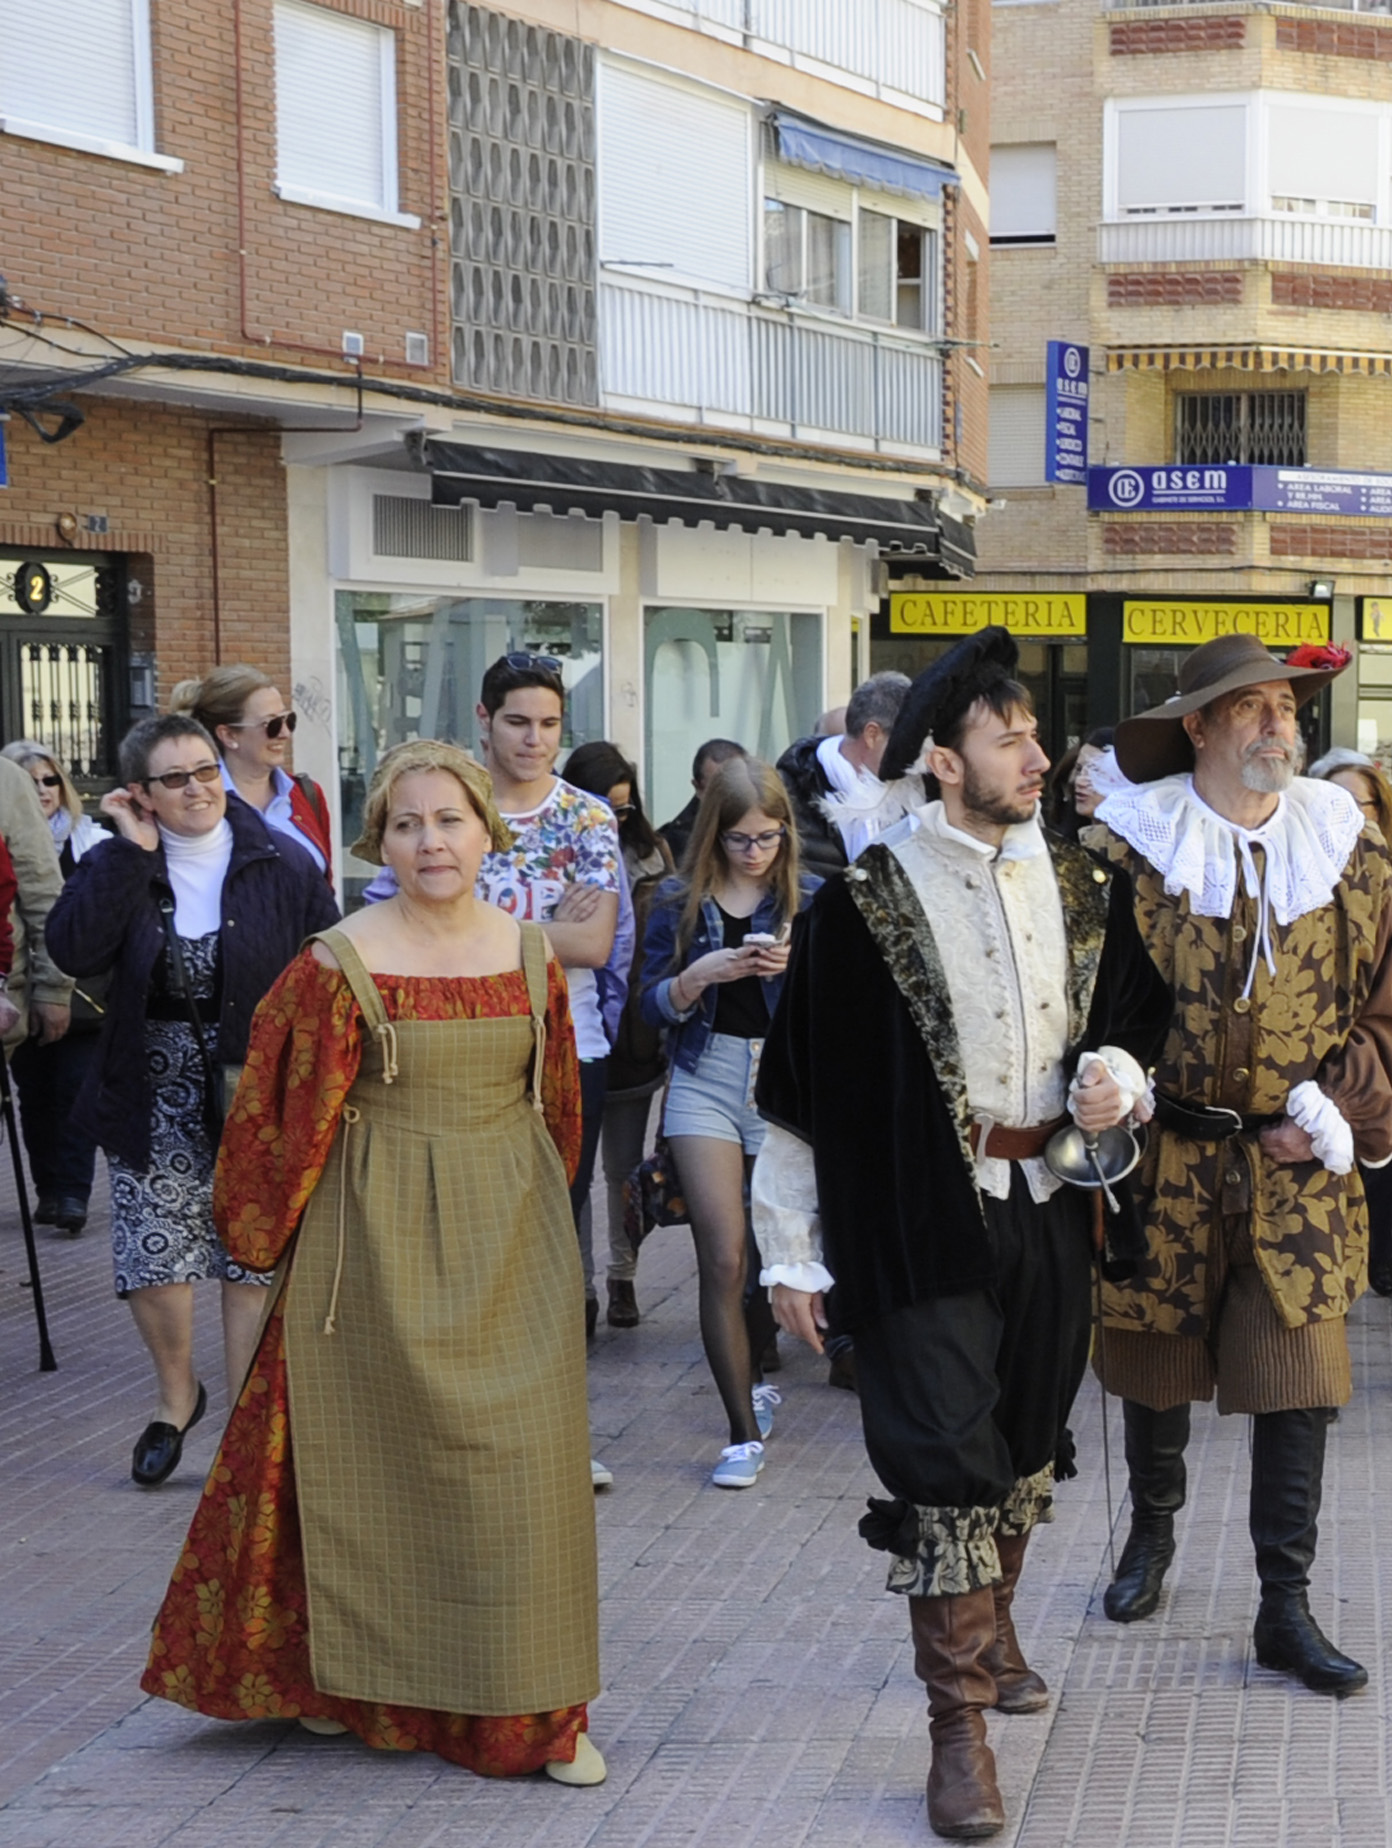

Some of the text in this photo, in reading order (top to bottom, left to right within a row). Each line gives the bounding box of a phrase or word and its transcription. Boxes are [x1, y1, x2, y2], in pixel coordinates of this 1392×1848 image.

[1152, 470, 1227, 489] asem
[1313, 484, 1352, 494] LABORAL
[1369, 488, 1392, 496] AREA
[1287, 500, 1340, 510] AREA FISCAL
[1369, 496, 1391, 504] AREA
[30, 576, 44, 601] 2
[899, 598, 1078, 628] CAFETERIA
[1127, 607, 1325, 639] CERVECERIA
